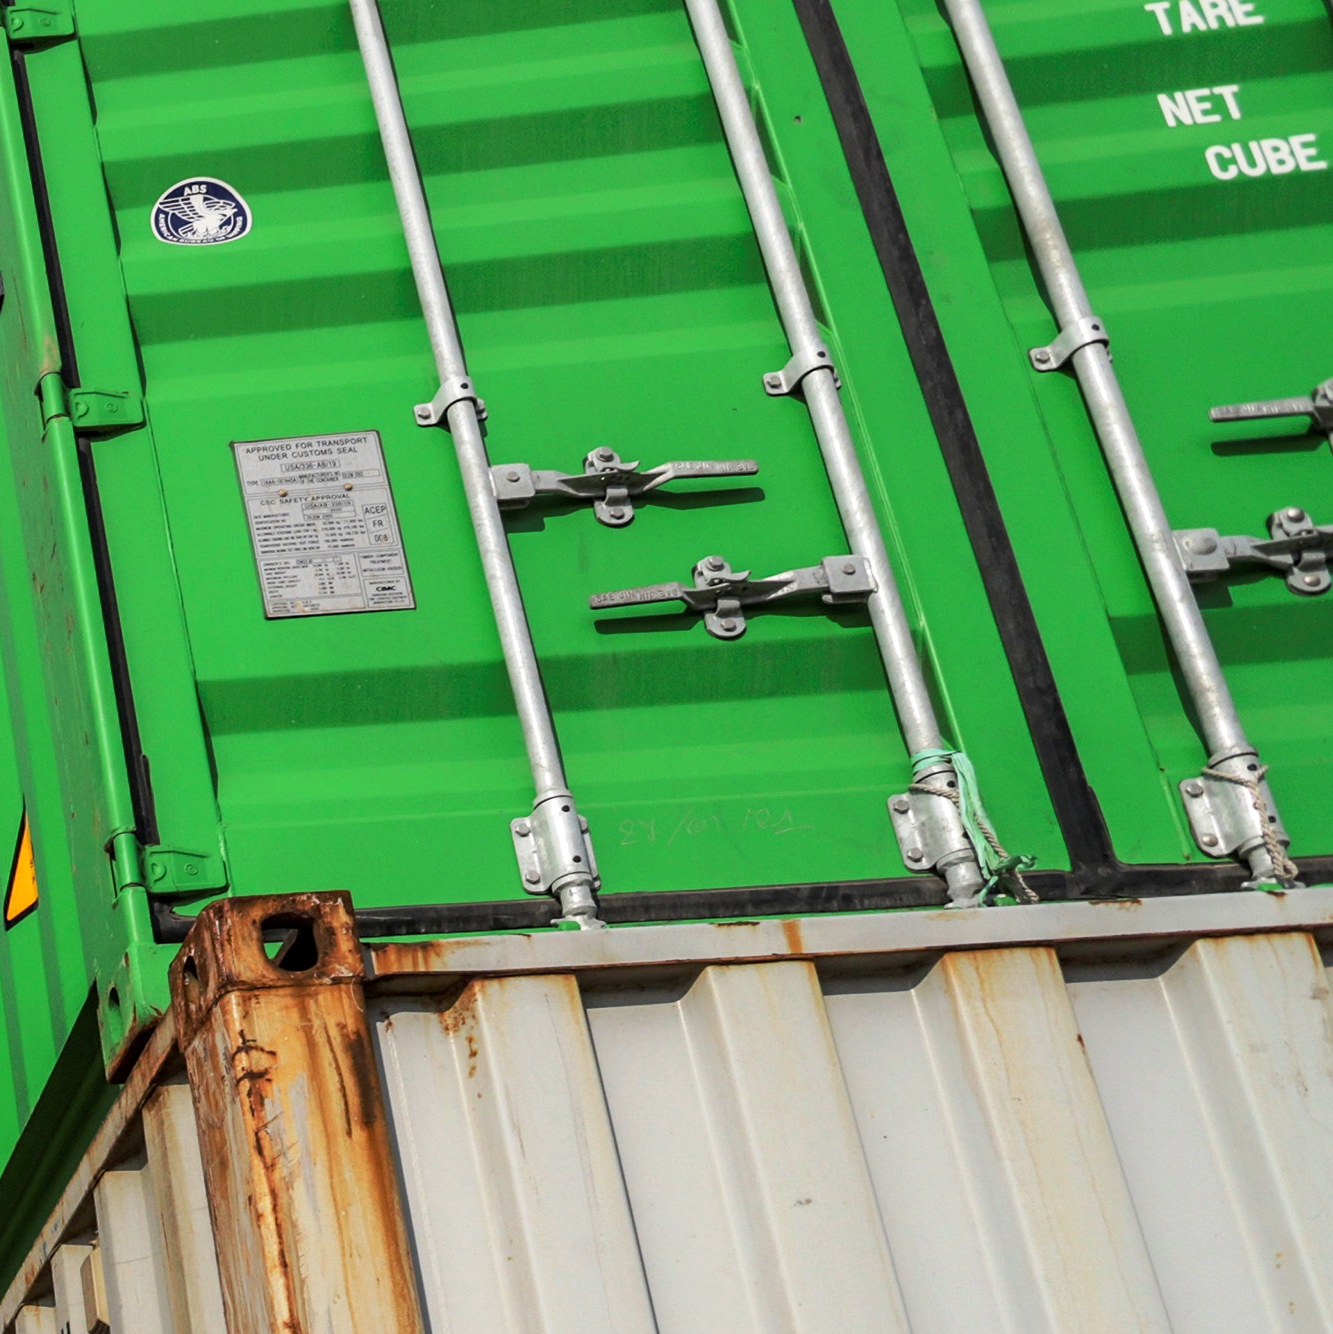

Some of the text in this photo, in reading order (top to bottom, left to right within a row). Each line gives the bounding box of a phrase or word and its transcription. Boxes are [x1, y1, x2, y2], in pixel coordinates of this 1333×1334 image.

[1144, 0, 1264, 35] TARE
[1157, 84, 1242, 127] NET
[1205, 133, 1328, 180] CUBE
[184, 185, 207, 196] ABS
[245, 436, 367, 454] APPROVED FOR TRANSPORT
[258, 446, 358, 461] UNDER CUSTOMS SEAL
[311, 493, 350, 501] APPROVAL
[365, 505, 386, 515] ACEP
[372, 520, 384, 528] FR
